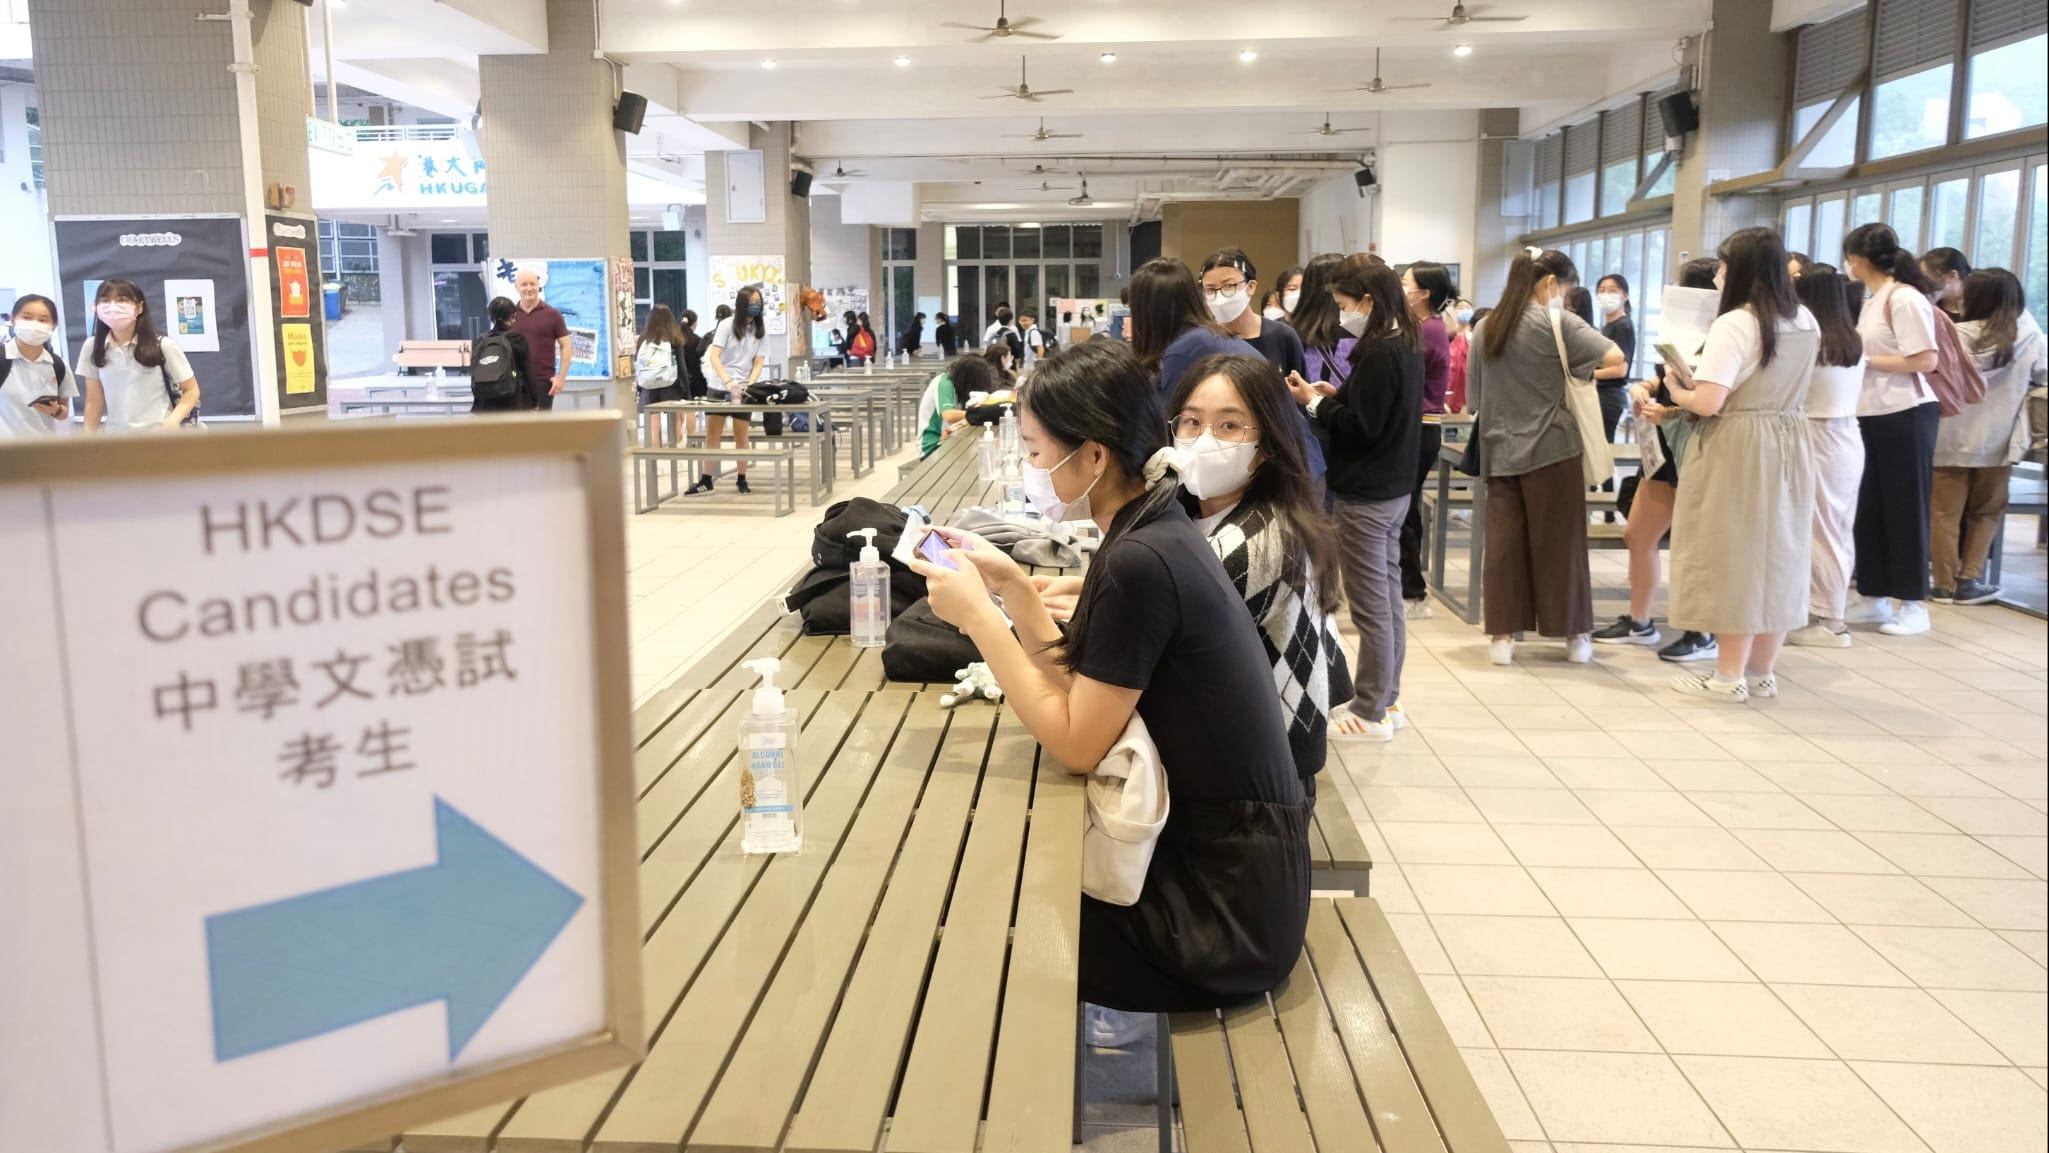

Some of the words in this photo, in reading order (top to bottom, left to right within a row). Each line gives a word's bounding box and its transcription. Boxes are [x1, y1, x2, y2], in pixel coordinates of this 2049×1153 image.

[200, 485, 453, 556] HKDSE
[136, 566, 515, 645] Candidates
[151, 629, 518, 733] 中學文憑試
[276, 720, 417, 791] 考生
